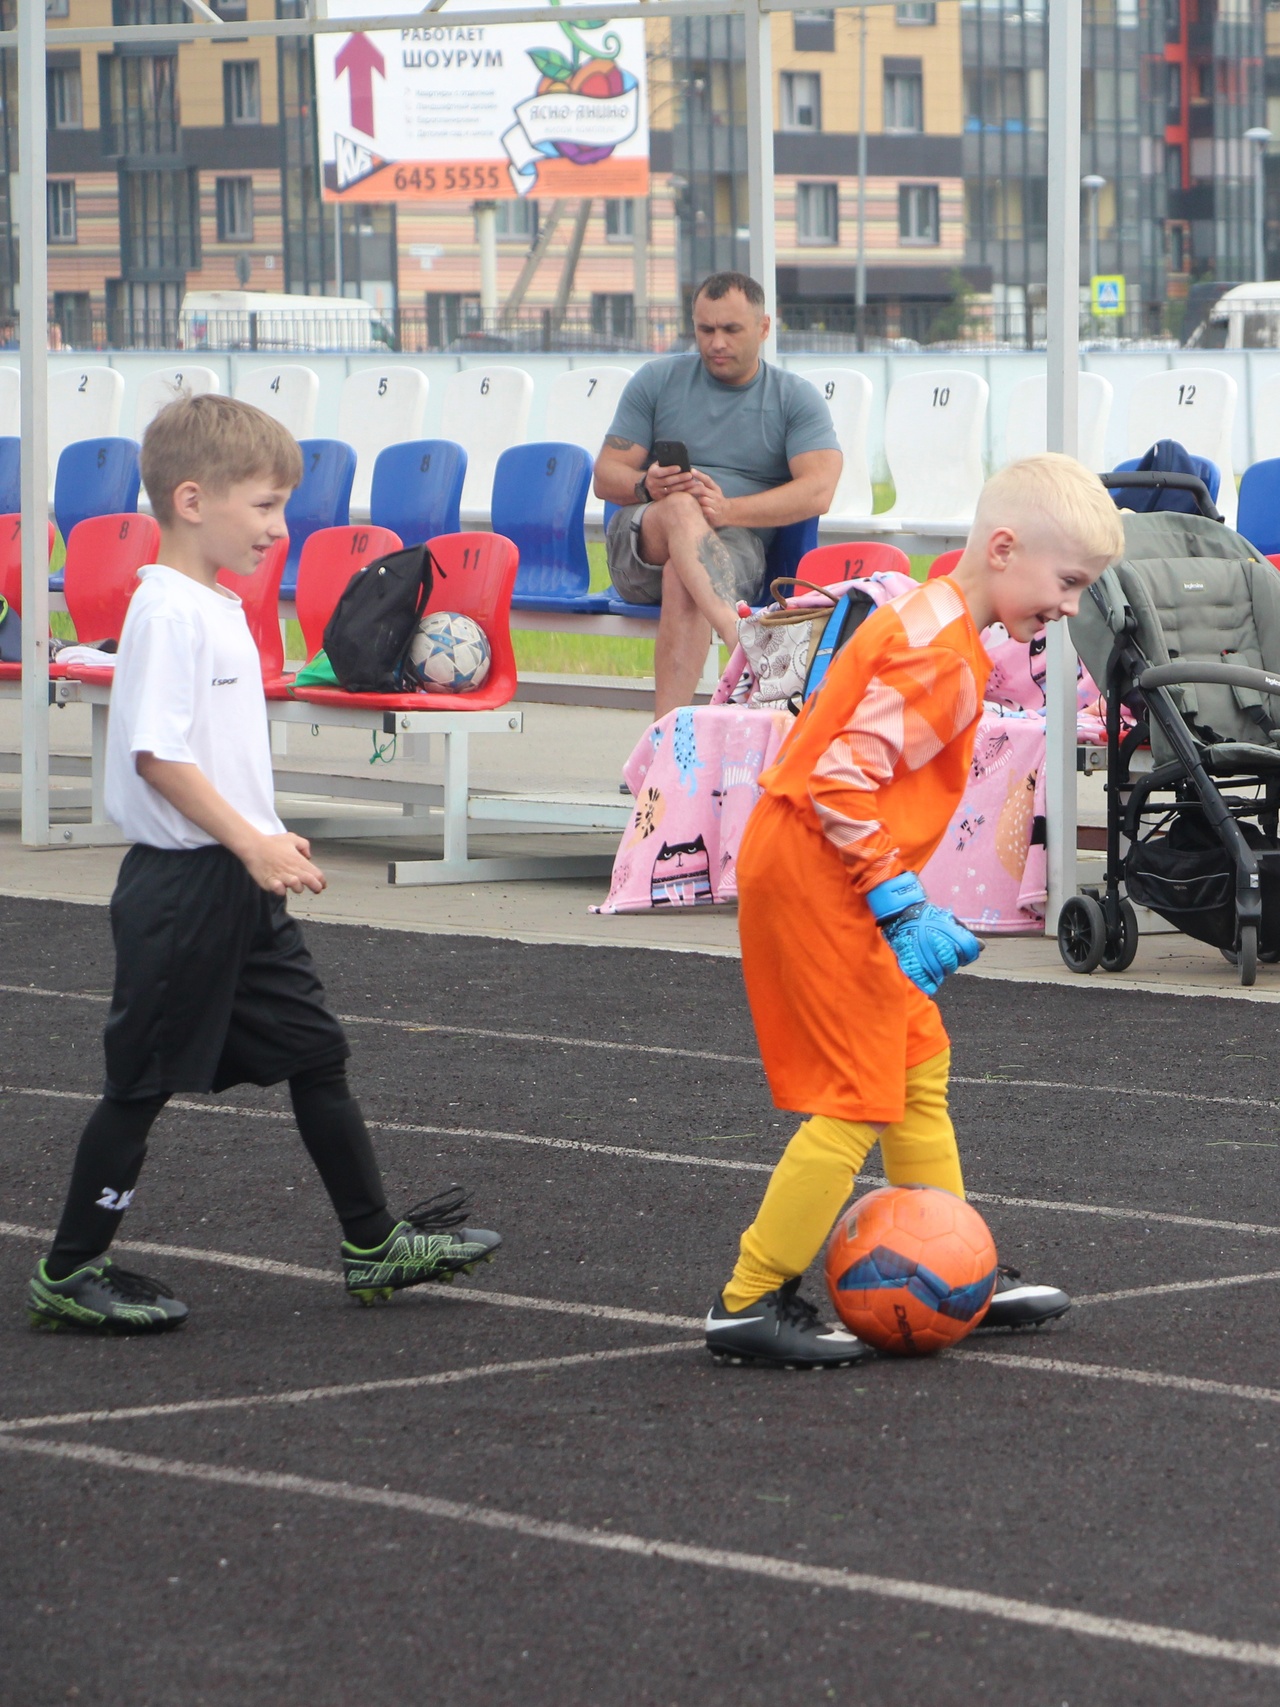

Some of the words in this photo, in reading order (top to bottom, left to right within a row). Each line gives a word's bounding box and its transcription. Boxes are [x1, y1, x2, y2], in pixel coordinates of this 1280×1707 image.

[401, 27, 486, 42] РАБОТАЕТ
[402, 50, 503, 68] ШОУРУМ
[394, 167, 437, 190] 645
[444, 165, 500, 190] 5555
[78, 374, 88, 392] 2
[174, 373, 183, 389] 3
[270, 375, 281, 393] 4
[377, 377, 388, 396] 5
[480, 377, 490, 395] 6
[587, 378, 598, 397] 7
[824, 380, 835, 400] 9
[932, 387, 950, 407] 10
[1178, 384, 1196, 405] 12
[310, 453, 320, 472] 7
[420, 454, 431, 472] 8
[546, 457, 557, 476] 9
[11, 521, 21, 541] 7
[119, 521, 129, 540] 8
[351, 532, 368, 554] 10
[463, 549, 481, 570] 11
[844, 559, 863, 580] 12
